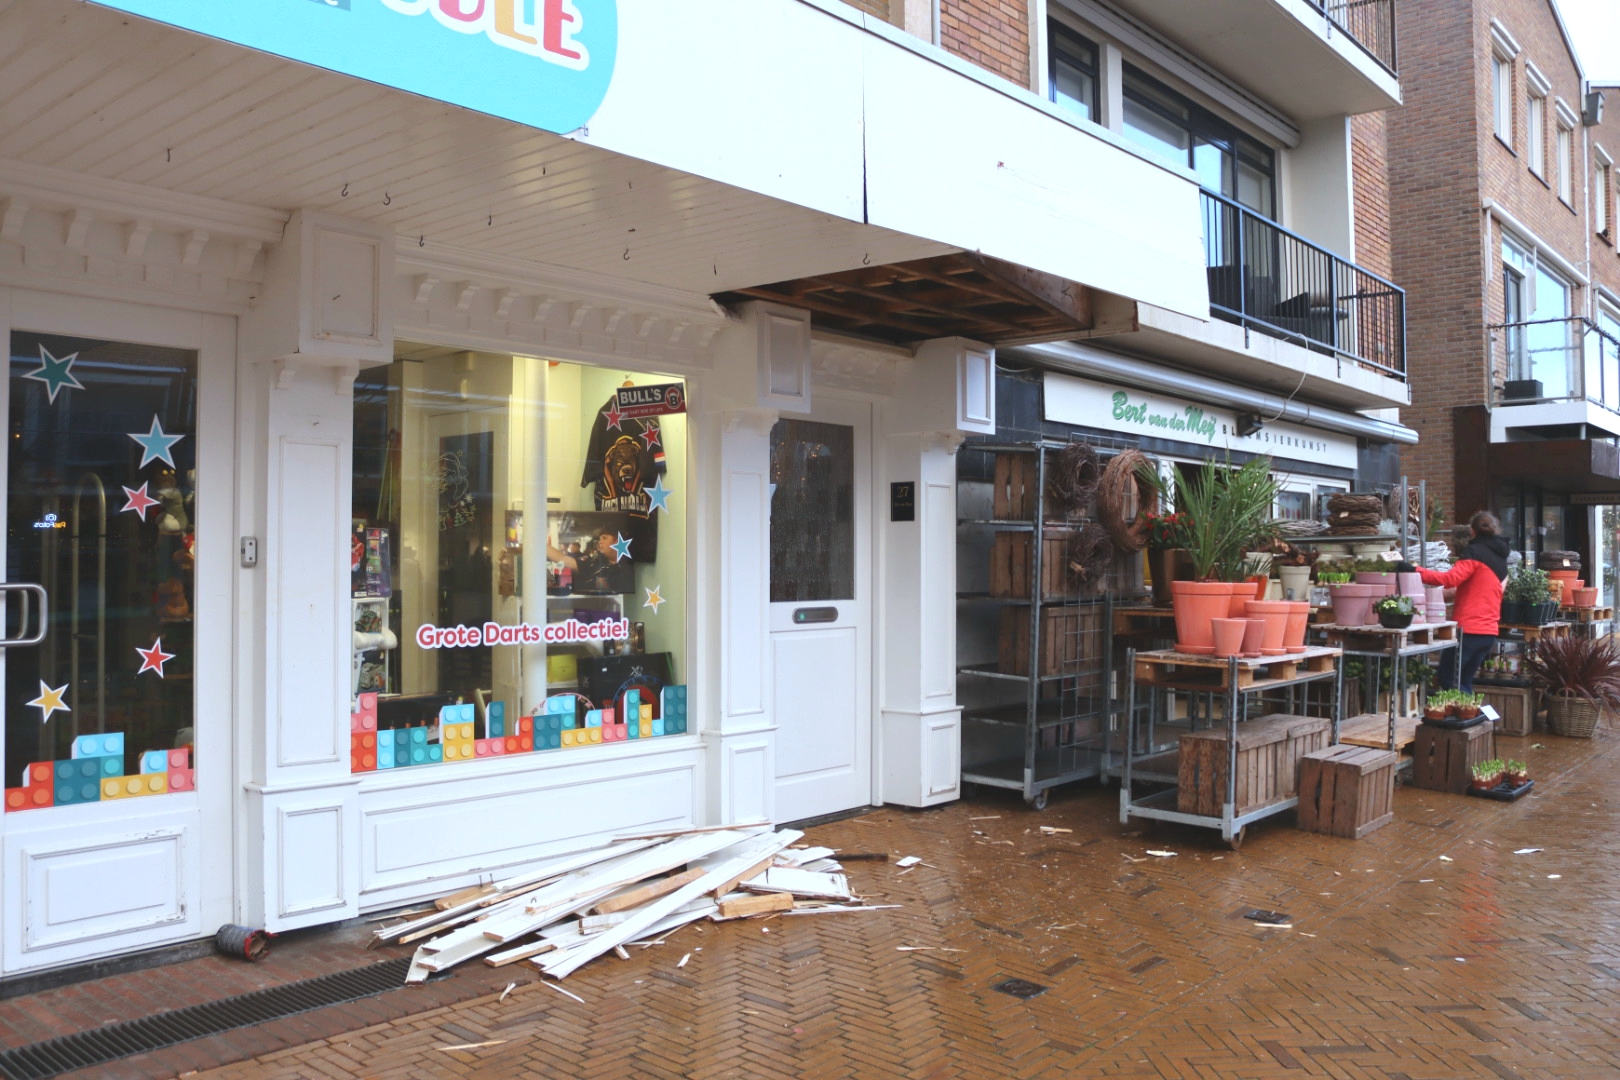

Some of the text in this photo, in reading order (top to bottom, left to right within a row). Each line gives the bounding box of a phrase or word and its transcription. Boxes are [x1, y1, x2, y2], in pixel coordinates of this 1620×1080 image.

[620, 388, 662, 404] BULL'S
[1112, 391, 1147, 424] Bert
[1148, 413, 1168, 429] van
[1168, 412, 1185, 432] der
[1222, 424, 1327, 453] BLMSIERKUNST
[896, 486, 909, 498] 27
[418, 617, 629, 647] Grote Darts collectie!
